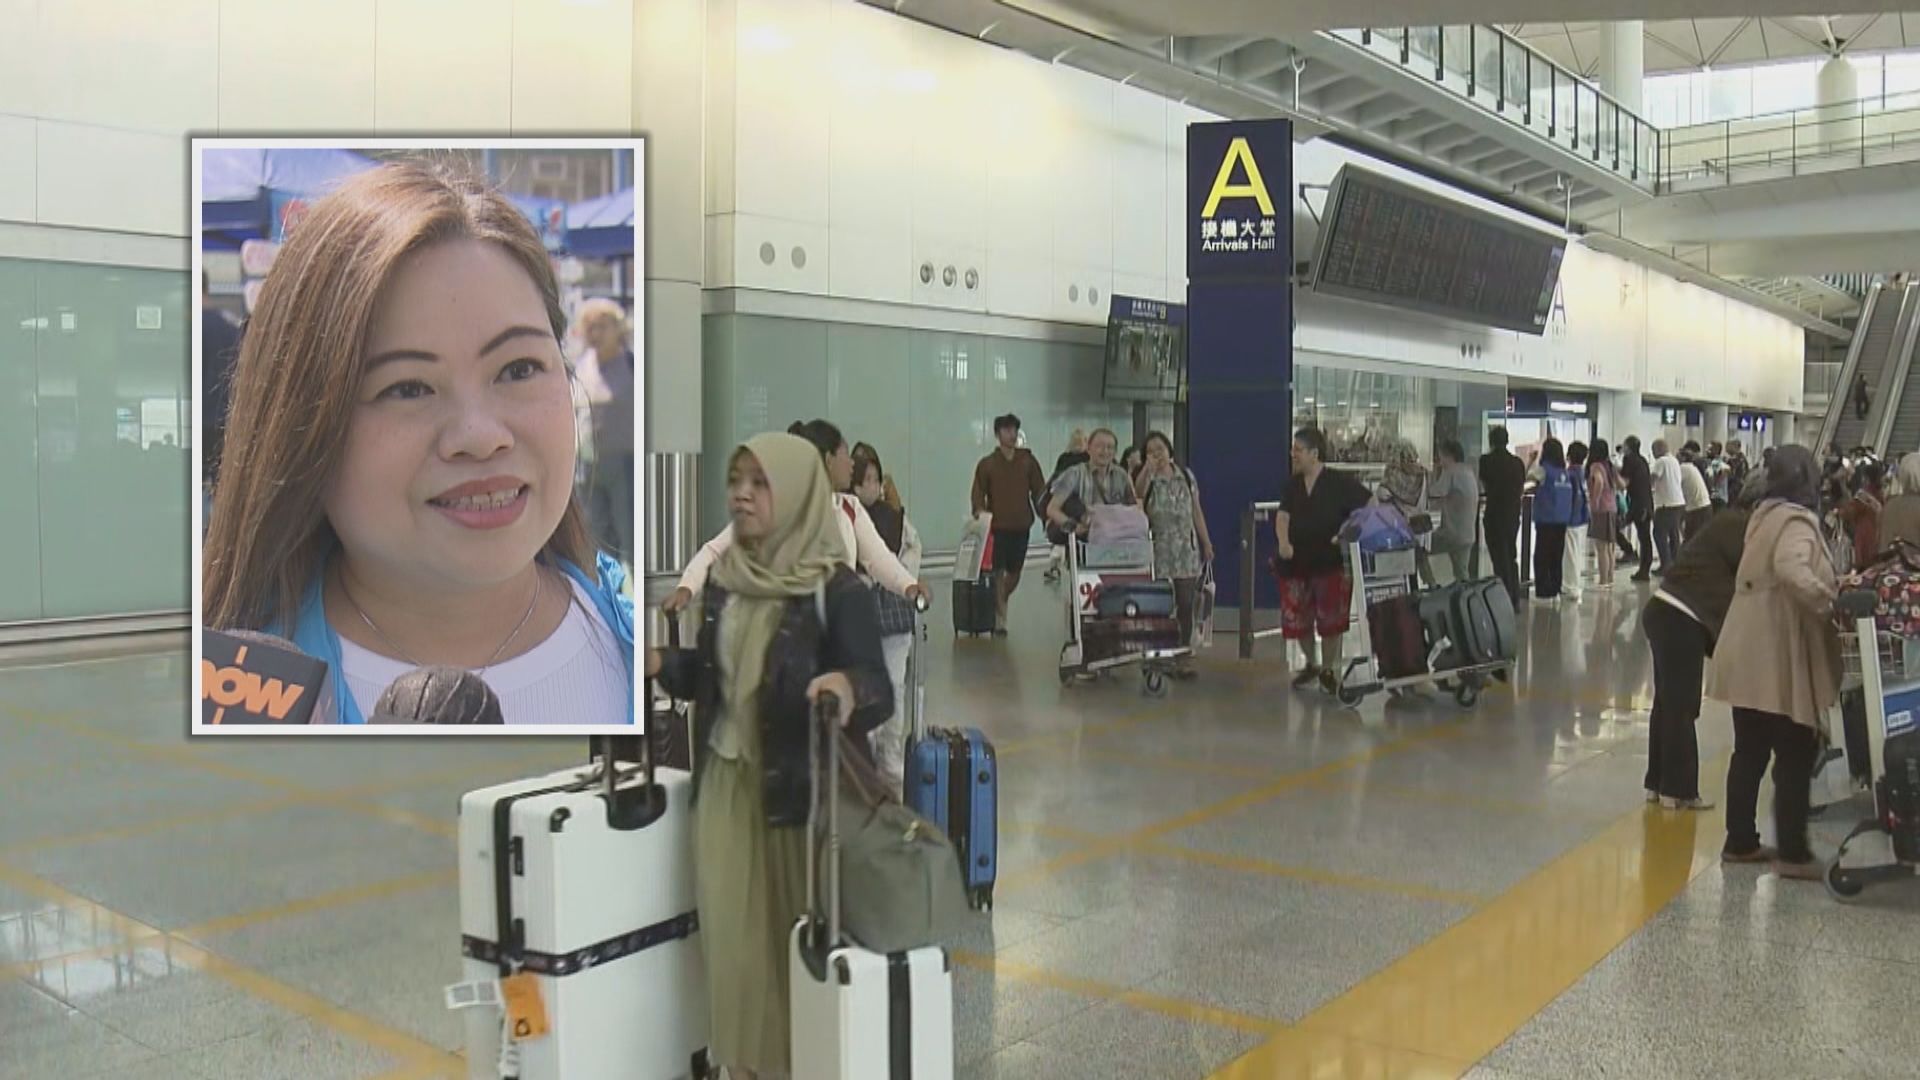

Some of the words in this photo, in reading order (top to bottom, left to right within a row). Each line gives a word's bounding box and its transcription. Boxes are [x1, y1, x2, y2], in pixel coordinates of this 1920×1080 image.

[1200, 136, 1277, 218] A
[1202, 239, 1249, 251] Arrivals
[1252, 238, 1275, 250] Hall
